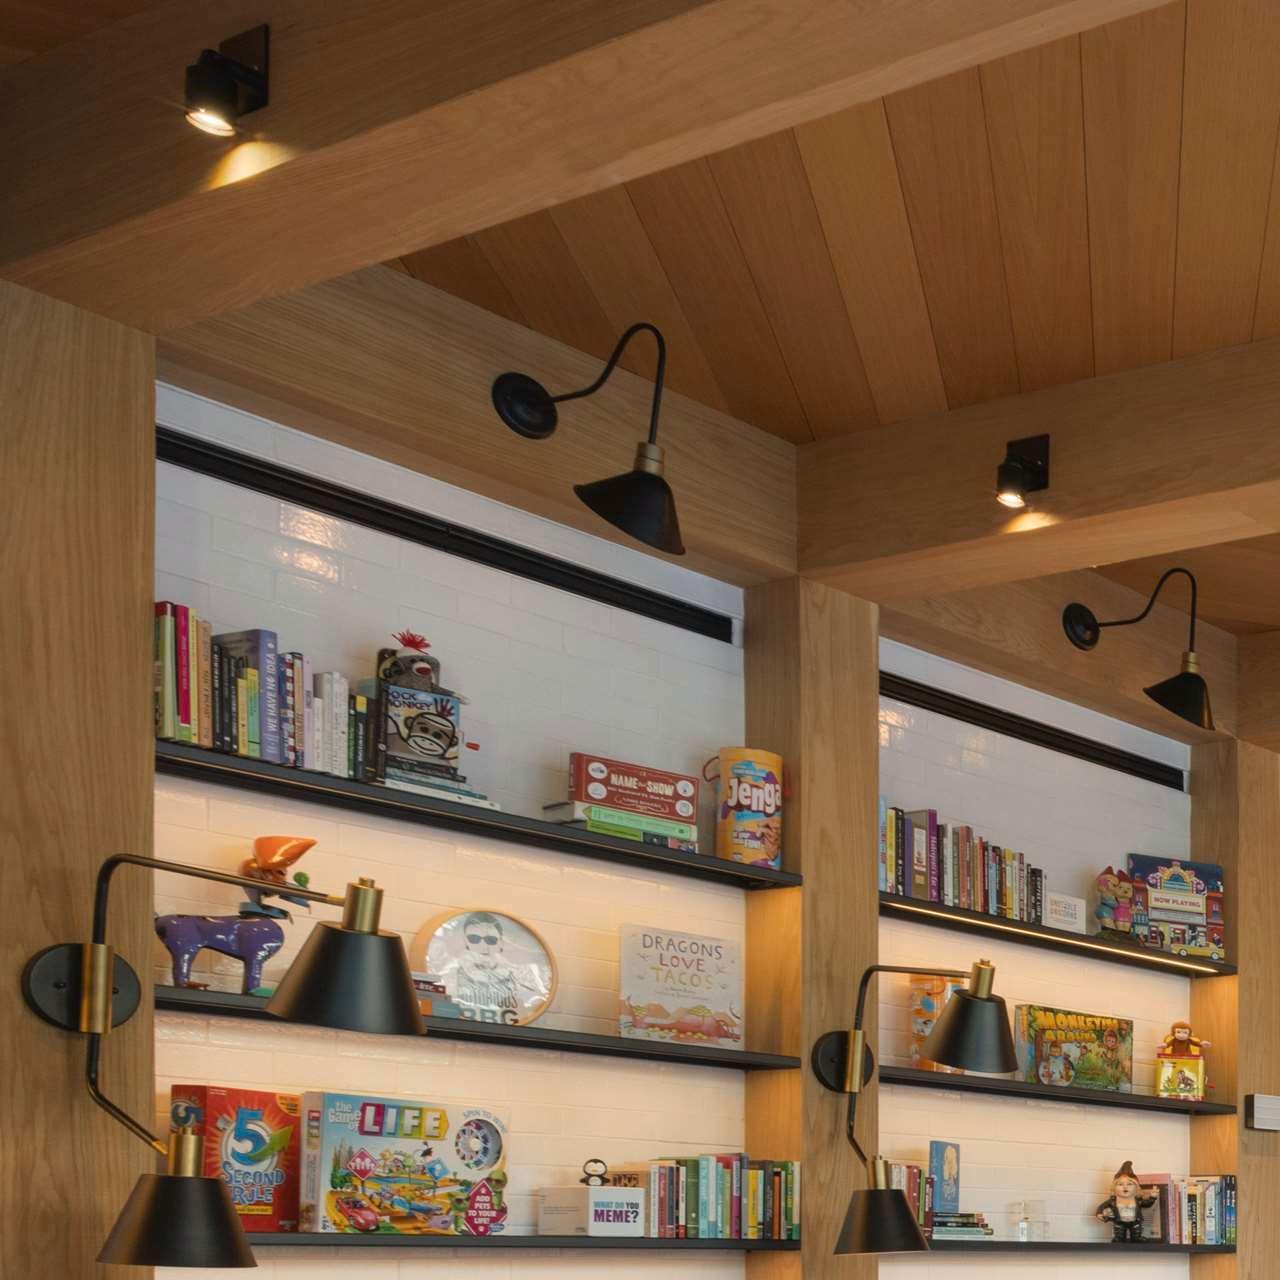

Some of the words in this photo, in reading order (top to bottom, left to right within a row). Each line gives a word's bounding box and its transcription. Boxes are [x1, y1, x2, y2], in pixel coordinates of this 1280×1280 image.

[265, 653, 276, 675] IDEA
[266, 691, 277, 716] HAVE
[610, 773, 638, 790] NAME
[646, 782, 675, 797] SHOW
[728, 777, 782, 815] Jenga
[1153, 896, 1171, 905] NOW
[1172, 898, 1201, 909] PLAYING
[642, 933, 723, 961] DRAGONS
[659, 953, 705, 973] LOVE
[649, 966, 714, 990] TACOS
[335, 1100, 353, 1113] the
[363, 1105, 442, 1137] LIFE
[231, 1106, 268, 1167] 5
[222, 1160, 286, 1186] SECOND
[231, 1186, 274, 1205] RULE
[475, 1195, 490, 1203] ADD
[626, 1201, 640, 1210] YOU
[468, 1210, 478, 1218] TO
[478, 1210, 497, 1218] YOUR
[593, 1209, 640, 1224] MEME?
